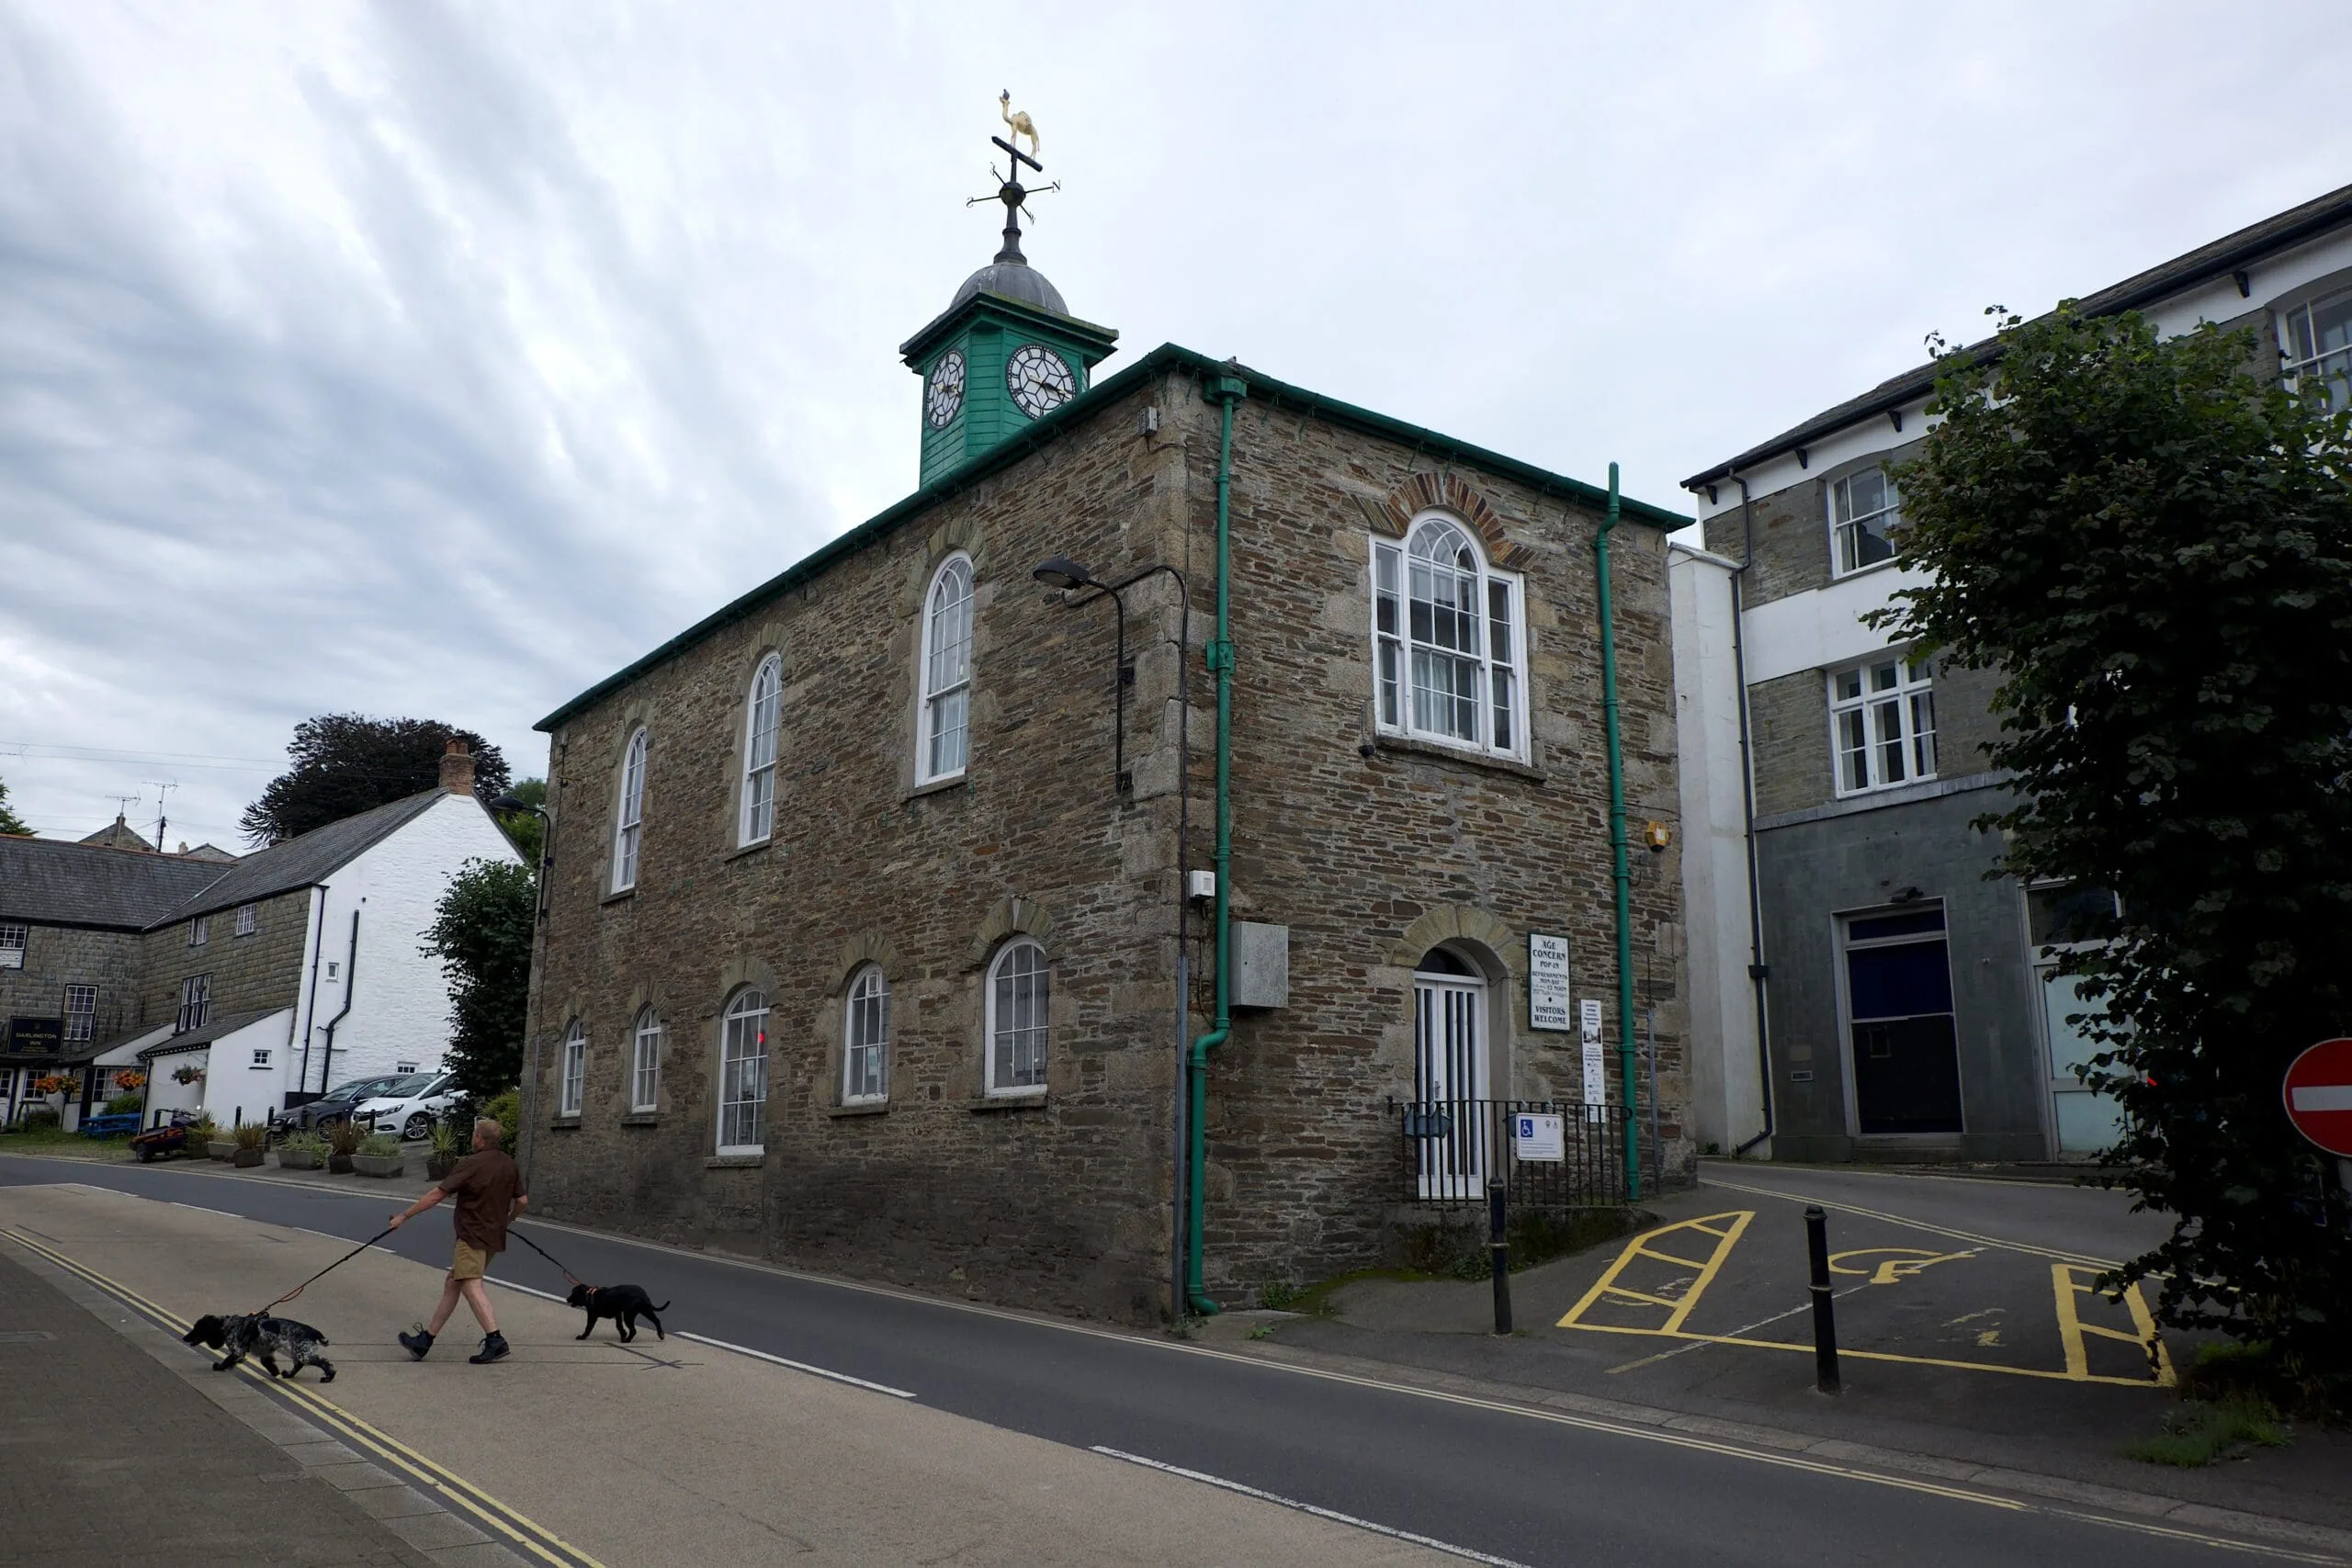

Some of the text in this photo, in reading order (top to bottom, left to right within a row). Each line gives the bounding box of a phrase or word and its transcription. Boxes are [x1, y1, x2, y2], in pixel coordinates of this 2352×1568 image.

[1052, 179, 1061, 193] N
[1543, 940, 1557, 950] AGE
[1532, 949, 1566, 961] CONCERN
[1535, 1006, 1566, 1016] VISITORS
[1533, 1014, 1566, 1025] WELCOME
[16, 1032, 57, 1040] DARLINGTON
